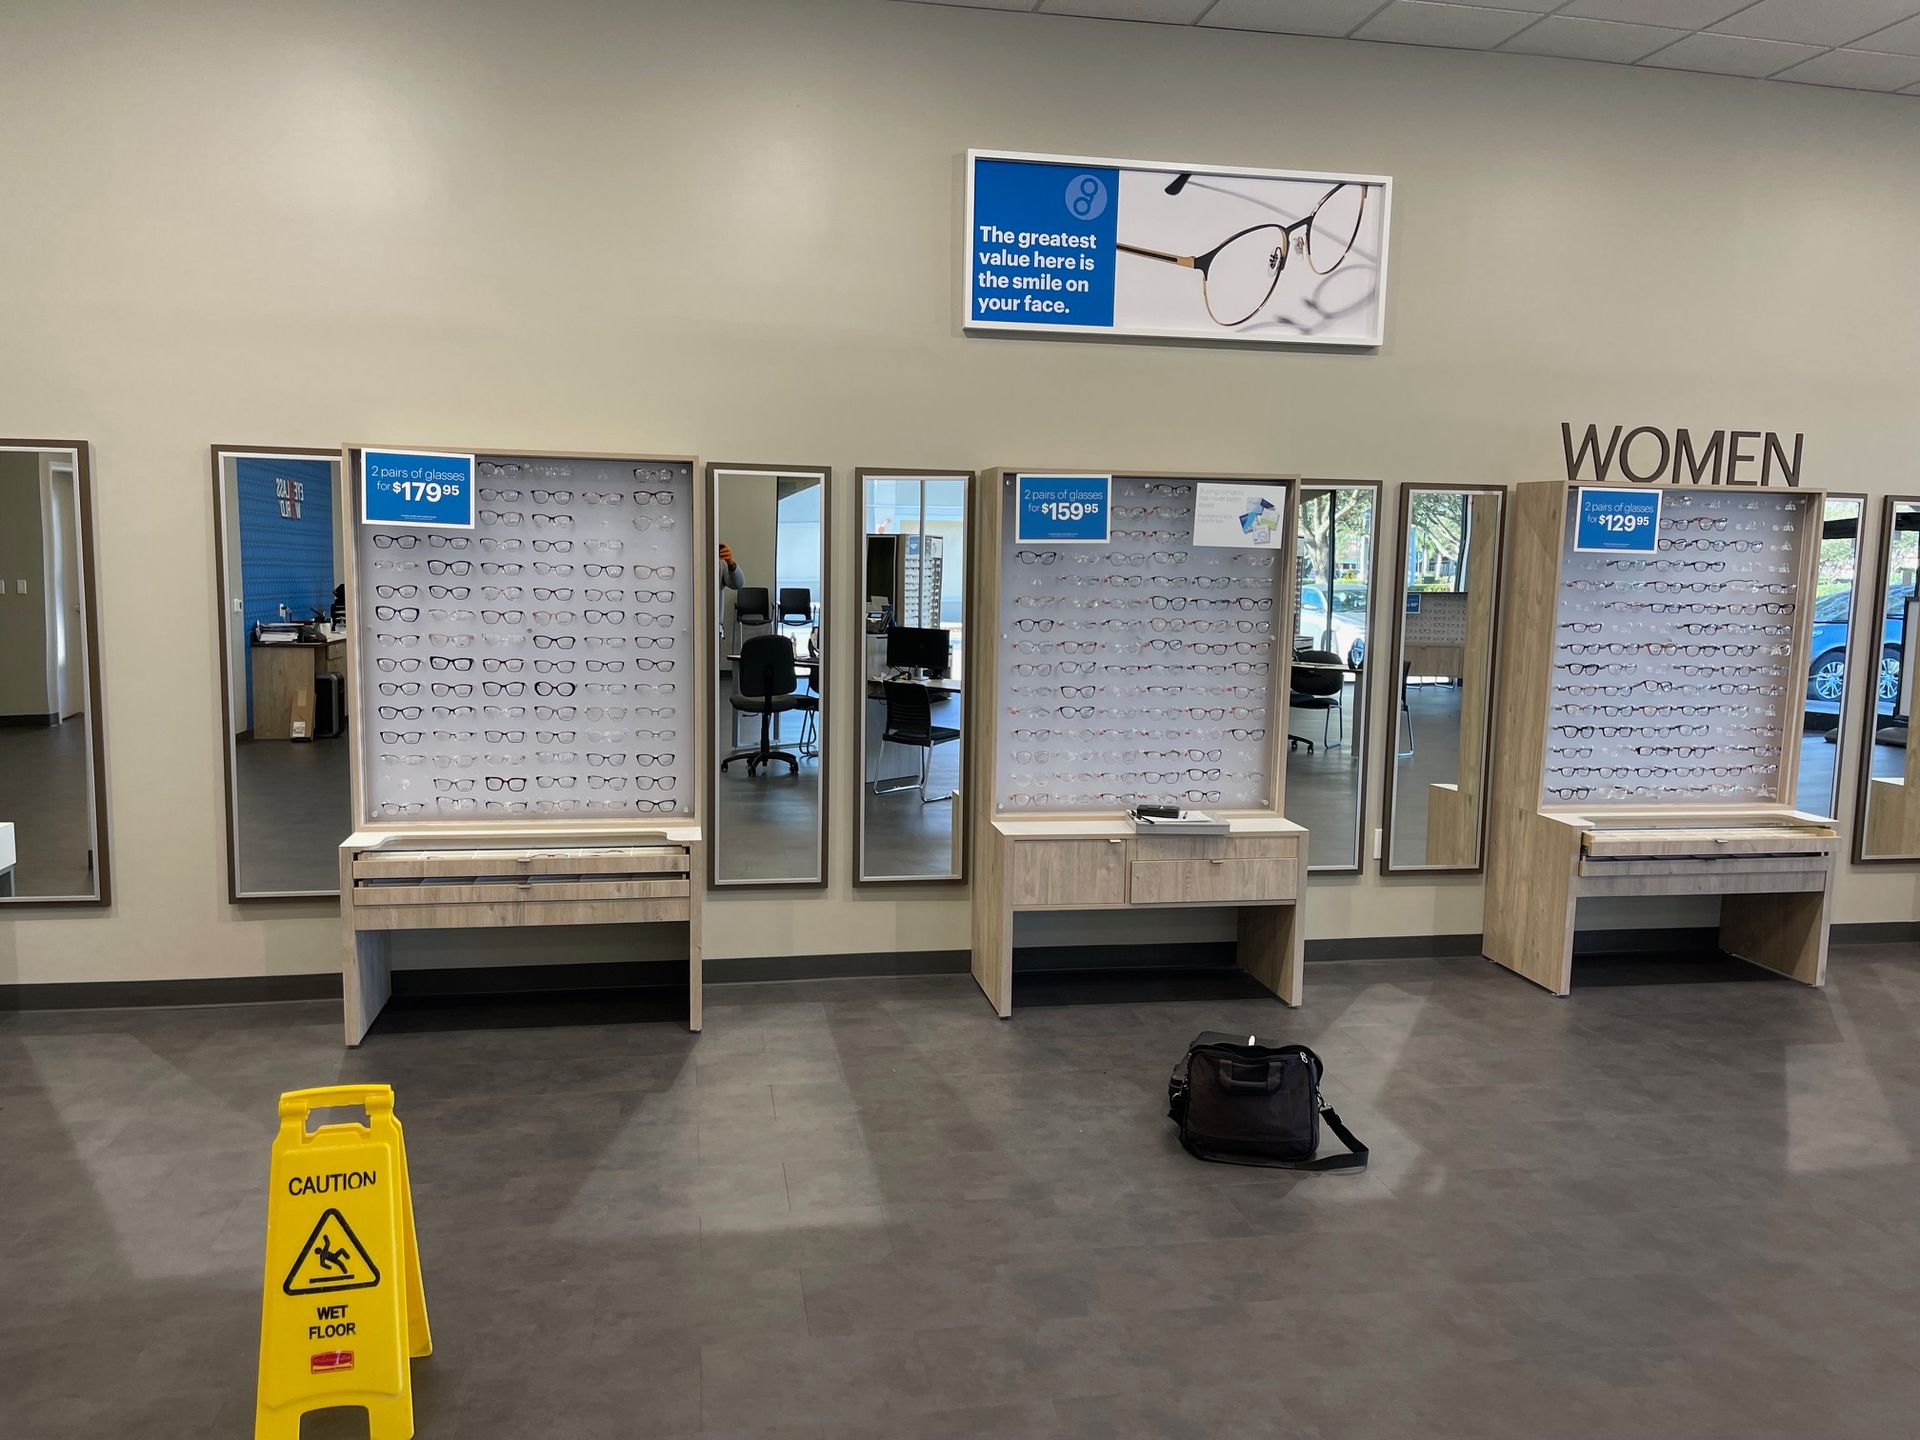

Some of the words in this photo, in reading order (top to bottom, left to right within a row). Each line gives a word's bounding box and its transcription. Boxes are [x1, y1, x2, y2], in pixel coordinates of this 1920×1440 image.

[980, 226, 1014, 243] The
[1018, 232, 1097, 249] greatest
[979, 249, 1030, 267] value
[1033, 251, 1076, 270] here
[1080, 254, 1095, 271] is
[978, 271, 1008, 288] the
[1012, 274, 1062, 291] smile
[1065, 279, 1089, 292] on
[978, 297, 1020, 313] your
[1024, 295, 1070, 314] face.
[1561, 422, 1804, 487] WOMEN
[371, 465, 379, 477] 2
[381, 468, 408, 479] pairs
[411, 468, 423, 479] of
[424, 469, 465, 482] glasses
[377, 480, 390, 491] for
[1024, 489, 1031, 500] 2
[1032, 490, 1056, 501] pairs
[1057, 489, 1068, 500] of
[1069, 489, 1103, 502] glasses
[1028, 503, 1040, 513] for
[1585, 501, 1592, 511] 2
[1592, 503, 1613, 512] pairs
[1613, 502, 1624, 512] of
[1624, 503, 1654, 514] glasses
[1587, 514, 1599, 523] for
[288, 1170, 376, 1196] CAUTION
[316, 1304, 348, 1320] WET
[309, 1322, 356, 1340] FLOOR
